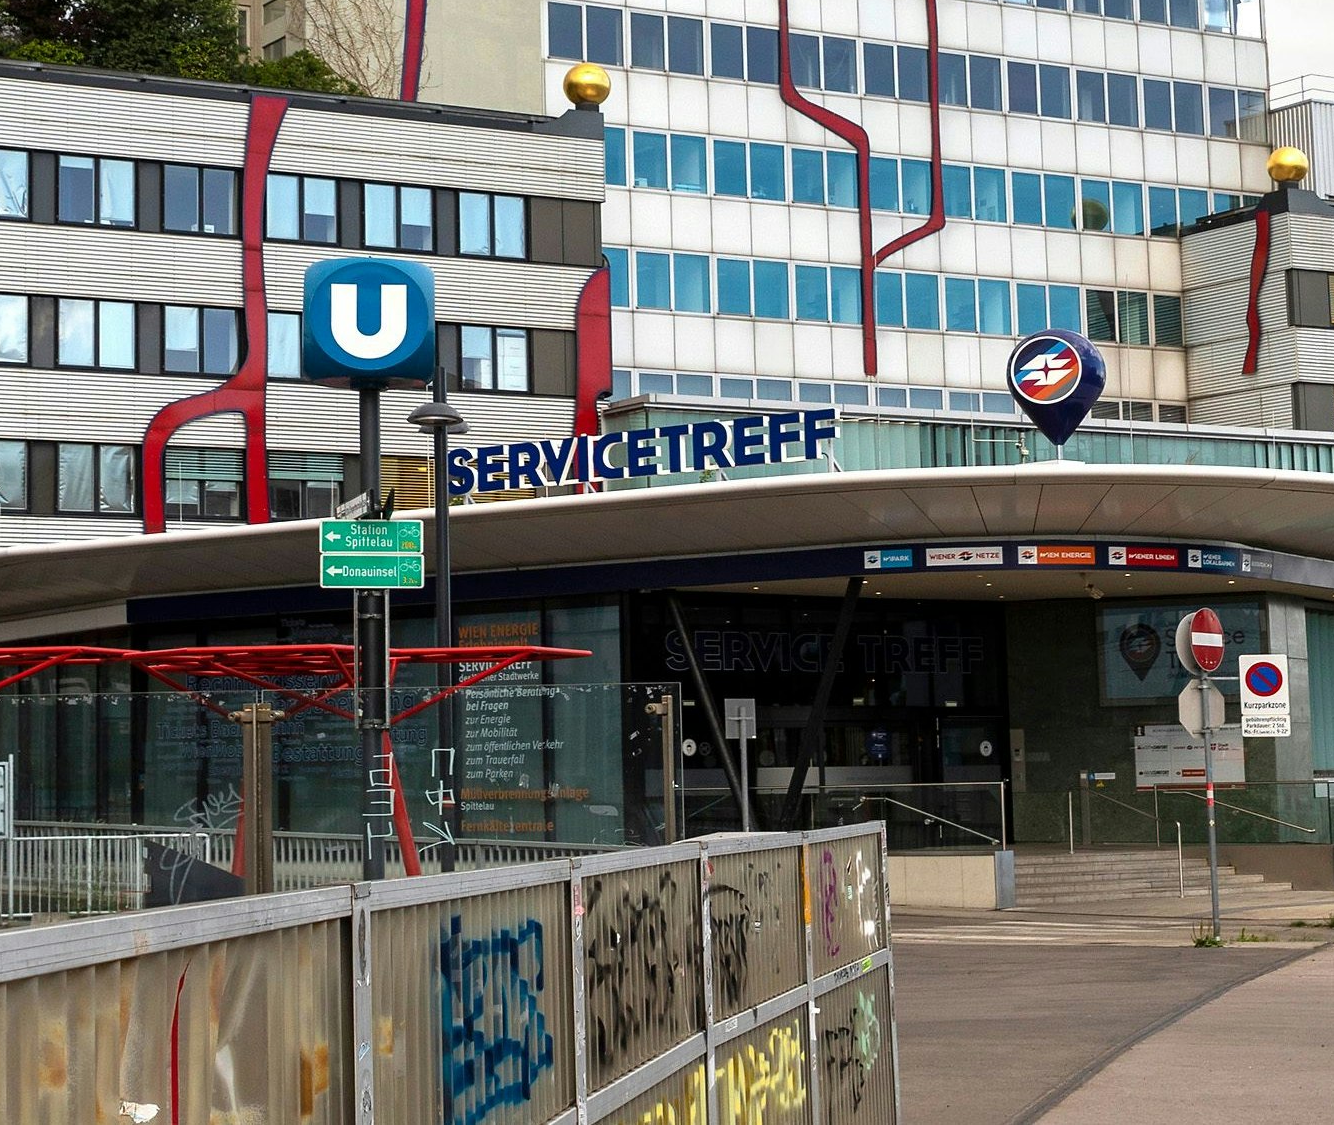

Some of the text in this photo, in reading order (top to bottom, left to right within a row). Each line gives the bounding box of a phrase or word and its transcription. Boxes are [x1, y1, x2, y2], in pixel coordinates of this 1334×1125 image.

[331, 283, 407, 359] U
[446, 408, 841, 496] SERVICETREFF
[350, 524, 387, 535] Station
[346, 536, 393, 549] Spittelau
[342, 566, 398, 577] Donauinsel
[491, 622, 539, 637] ENERGIE
[858, 634, 984, 674] TREFF
[498, 672, 539, 681] Stadtwerke
[465, 688, 515, 699] Persönliche
[465, 701, 509, 713] bei Fragen
[1244, 702, 1286, 710] Kurzparkzone
[465, 714, 511, 726] zur Energie
[465, 727, 518, 738] zur Mobilität
[465, 739, 564, 753] zum öffentlichen Verkehr
[465, 754, 525, 767] zum Trauerfall
[466, 768, 513, 779] zum Parken
[460, 802, 495, 812] Spittelau
[461, 819, 555, 833] Fernkälteentrale
